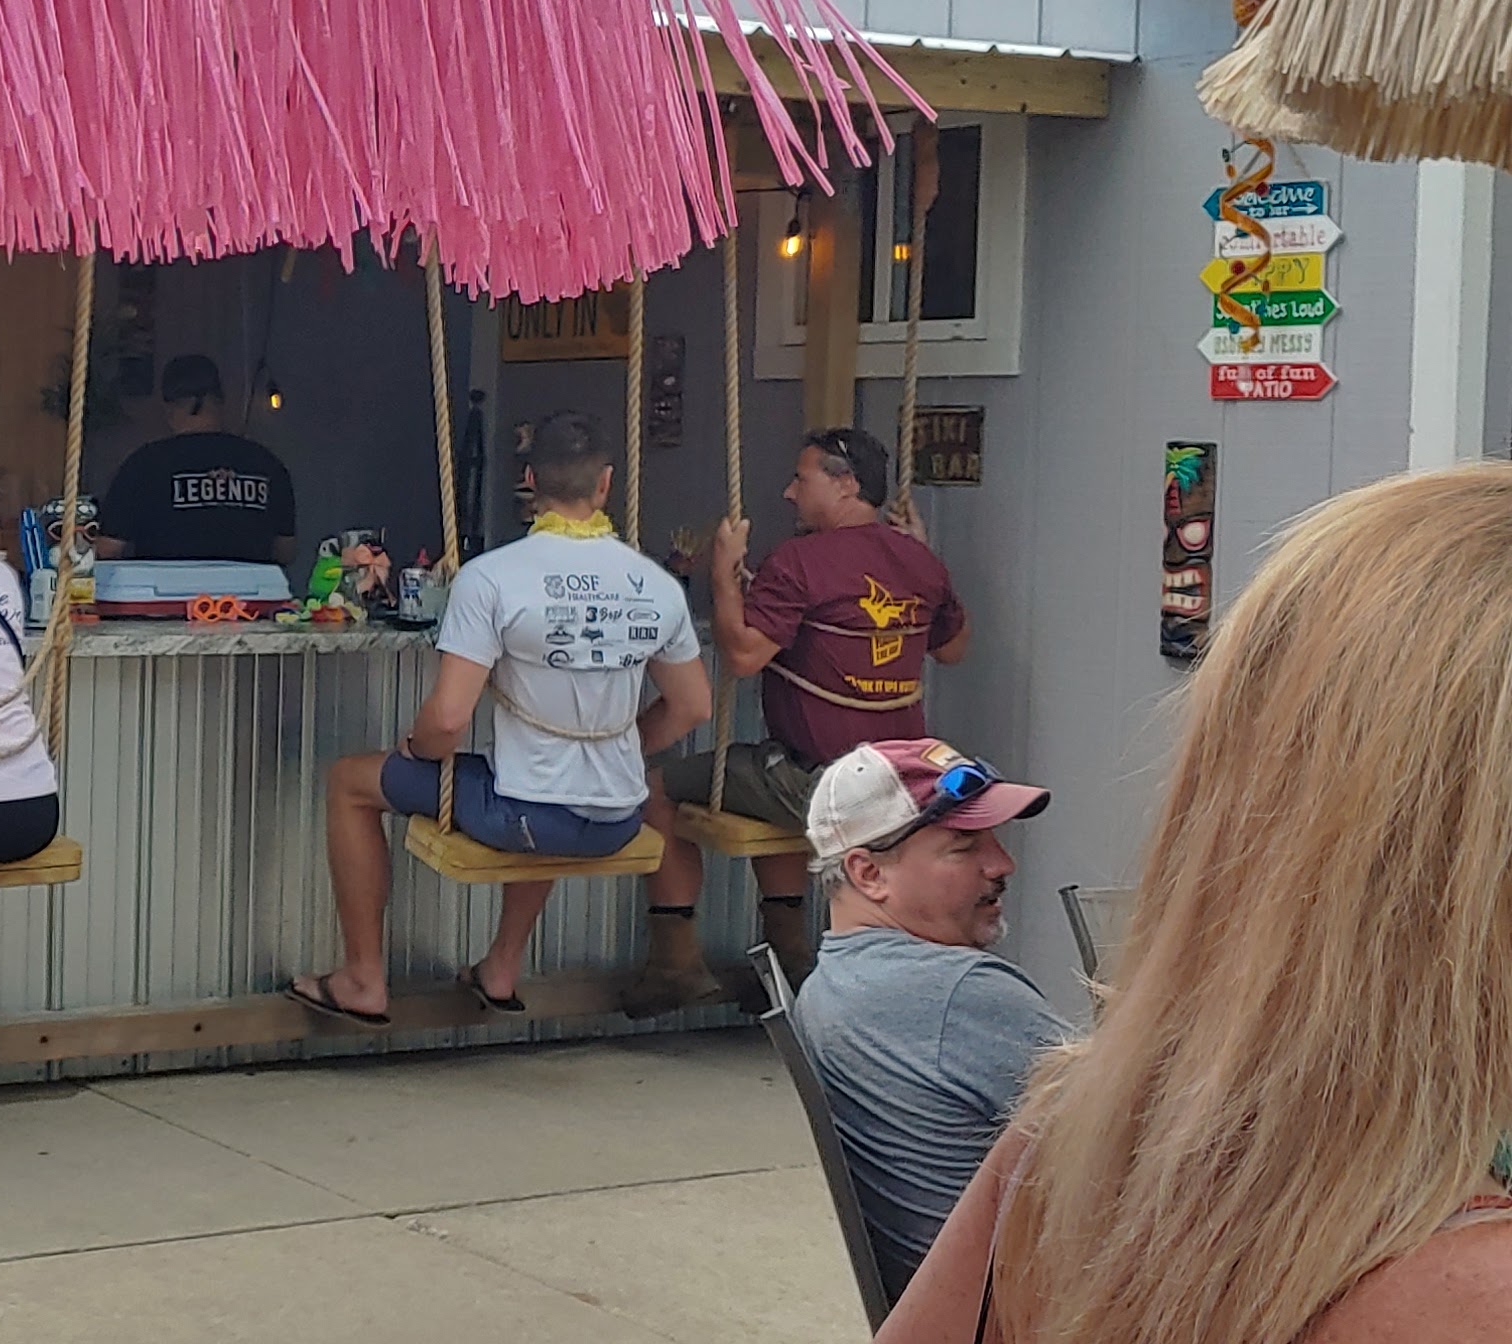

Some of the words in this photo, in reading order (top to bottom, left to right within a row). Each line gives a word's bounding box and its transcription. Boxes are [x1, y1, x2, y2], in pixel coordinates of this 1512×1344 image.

[1291, 297, 1325, 318] Loud
[1270, 333, 1312, 354] MESSY
[1255, 365, 1276, 381] of
[1281, 365, 1316, 381] fun
[931, 453, 979, 479] BAR
[173, 478, 268, 504] LEGENDS
[566, 574, 599, 592] OSF
